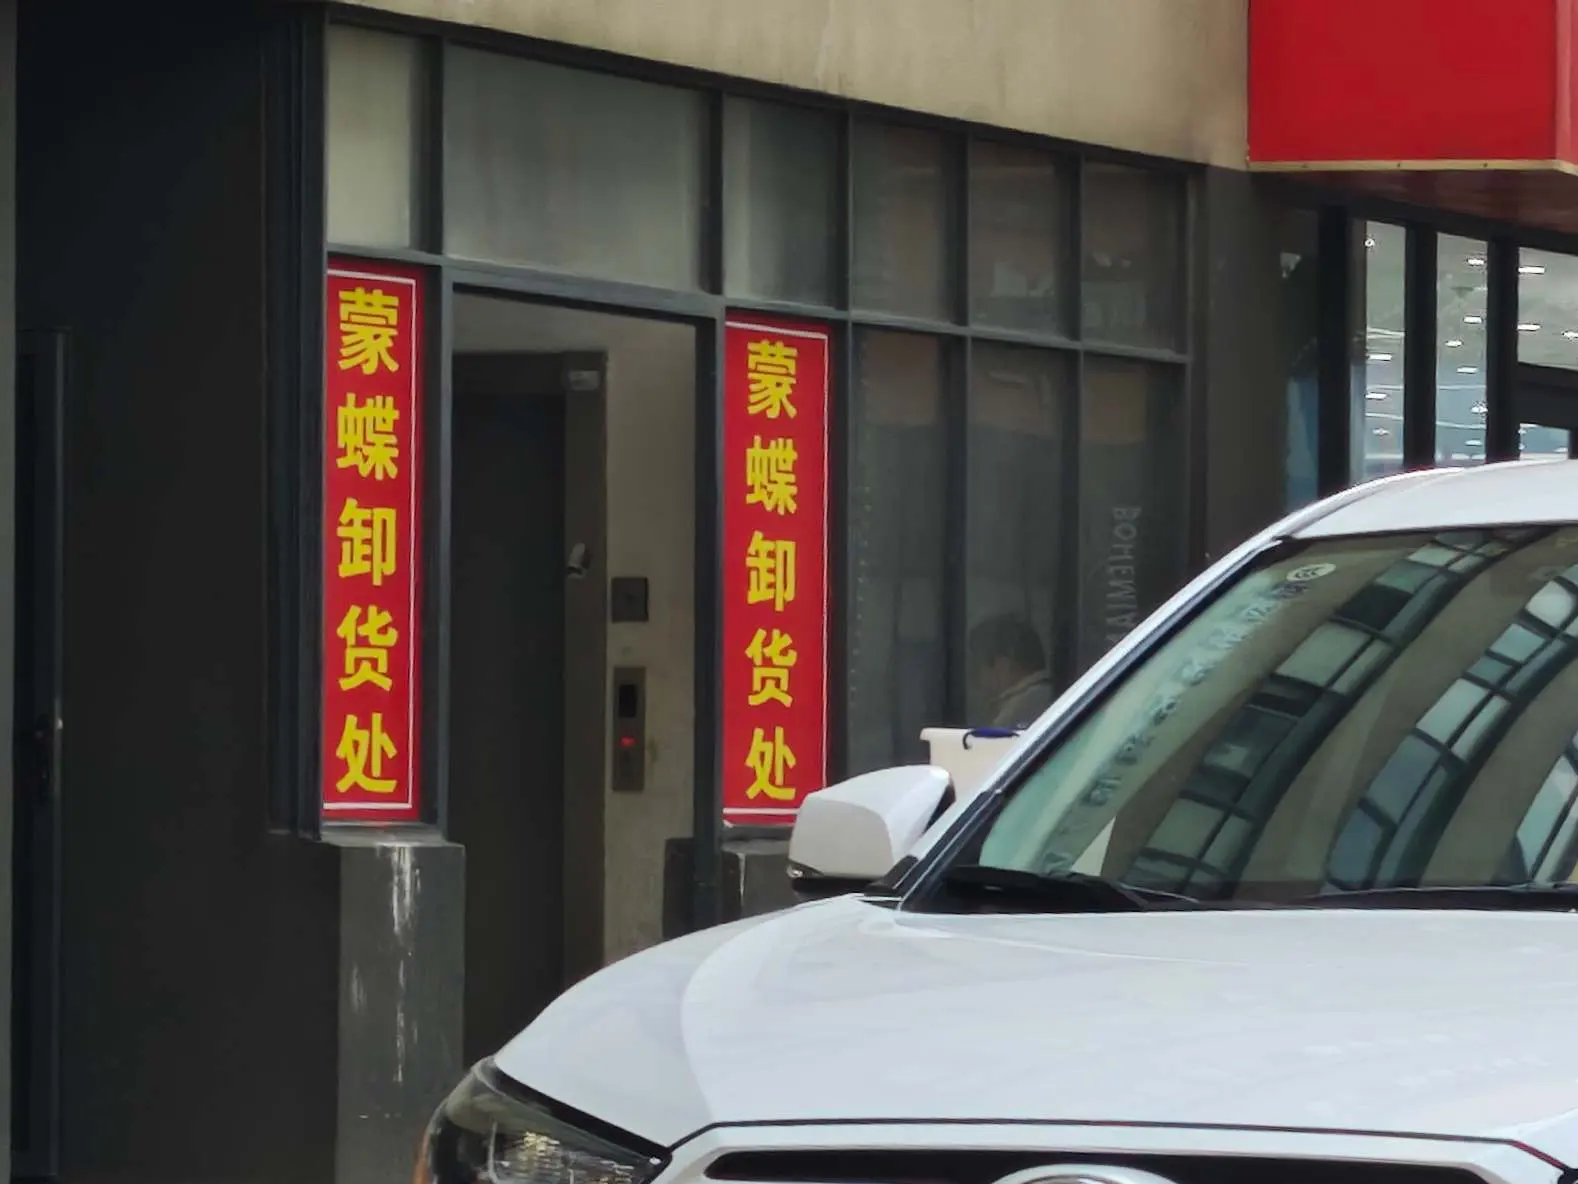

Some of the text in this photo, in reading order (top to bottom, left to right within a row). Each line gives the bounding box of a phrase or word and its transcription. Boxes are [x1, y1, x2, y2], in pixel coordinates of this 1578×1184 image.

[336, 286, 400, 794] 蒙蝶卸货处
[744, 340, 798, 800] 蒙蝶卸货处
